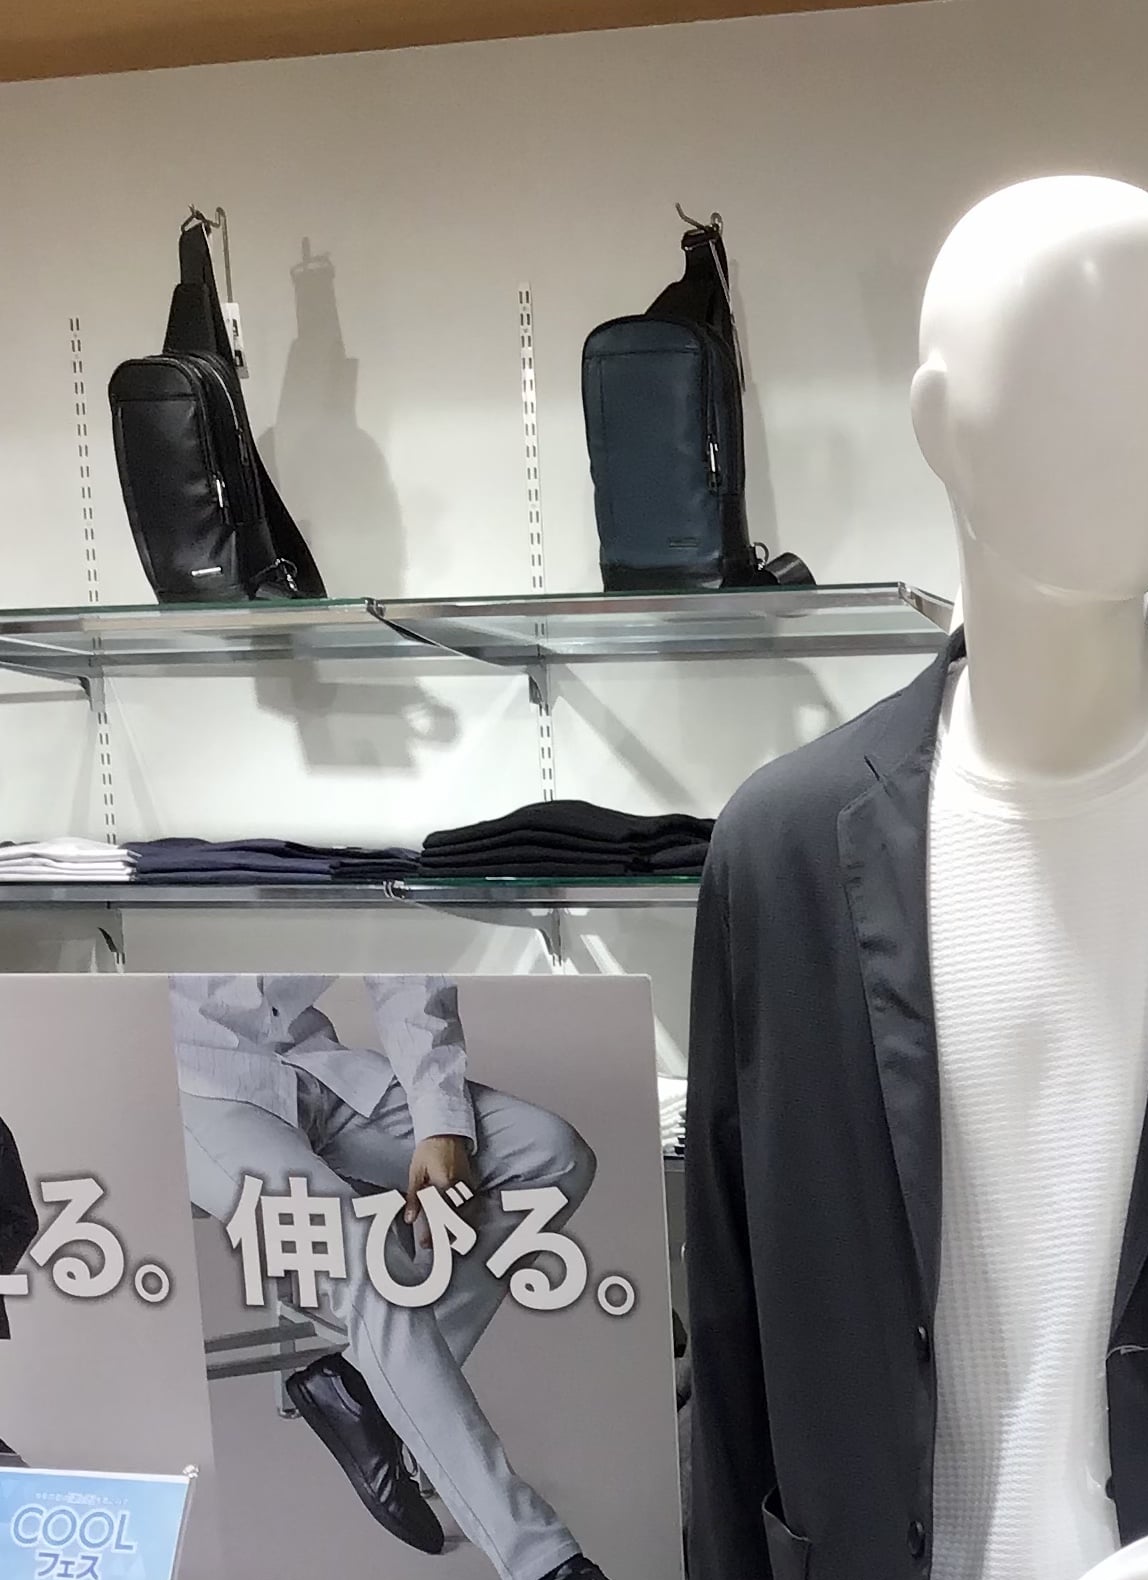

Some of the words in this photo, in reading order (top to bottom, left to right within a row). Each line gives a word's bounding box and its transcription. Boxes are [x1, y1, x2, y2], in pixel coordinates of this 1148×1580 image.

[226, 1174, 636, 1316] 伸びる。
[12, 1505, 135, 1552] COOL
